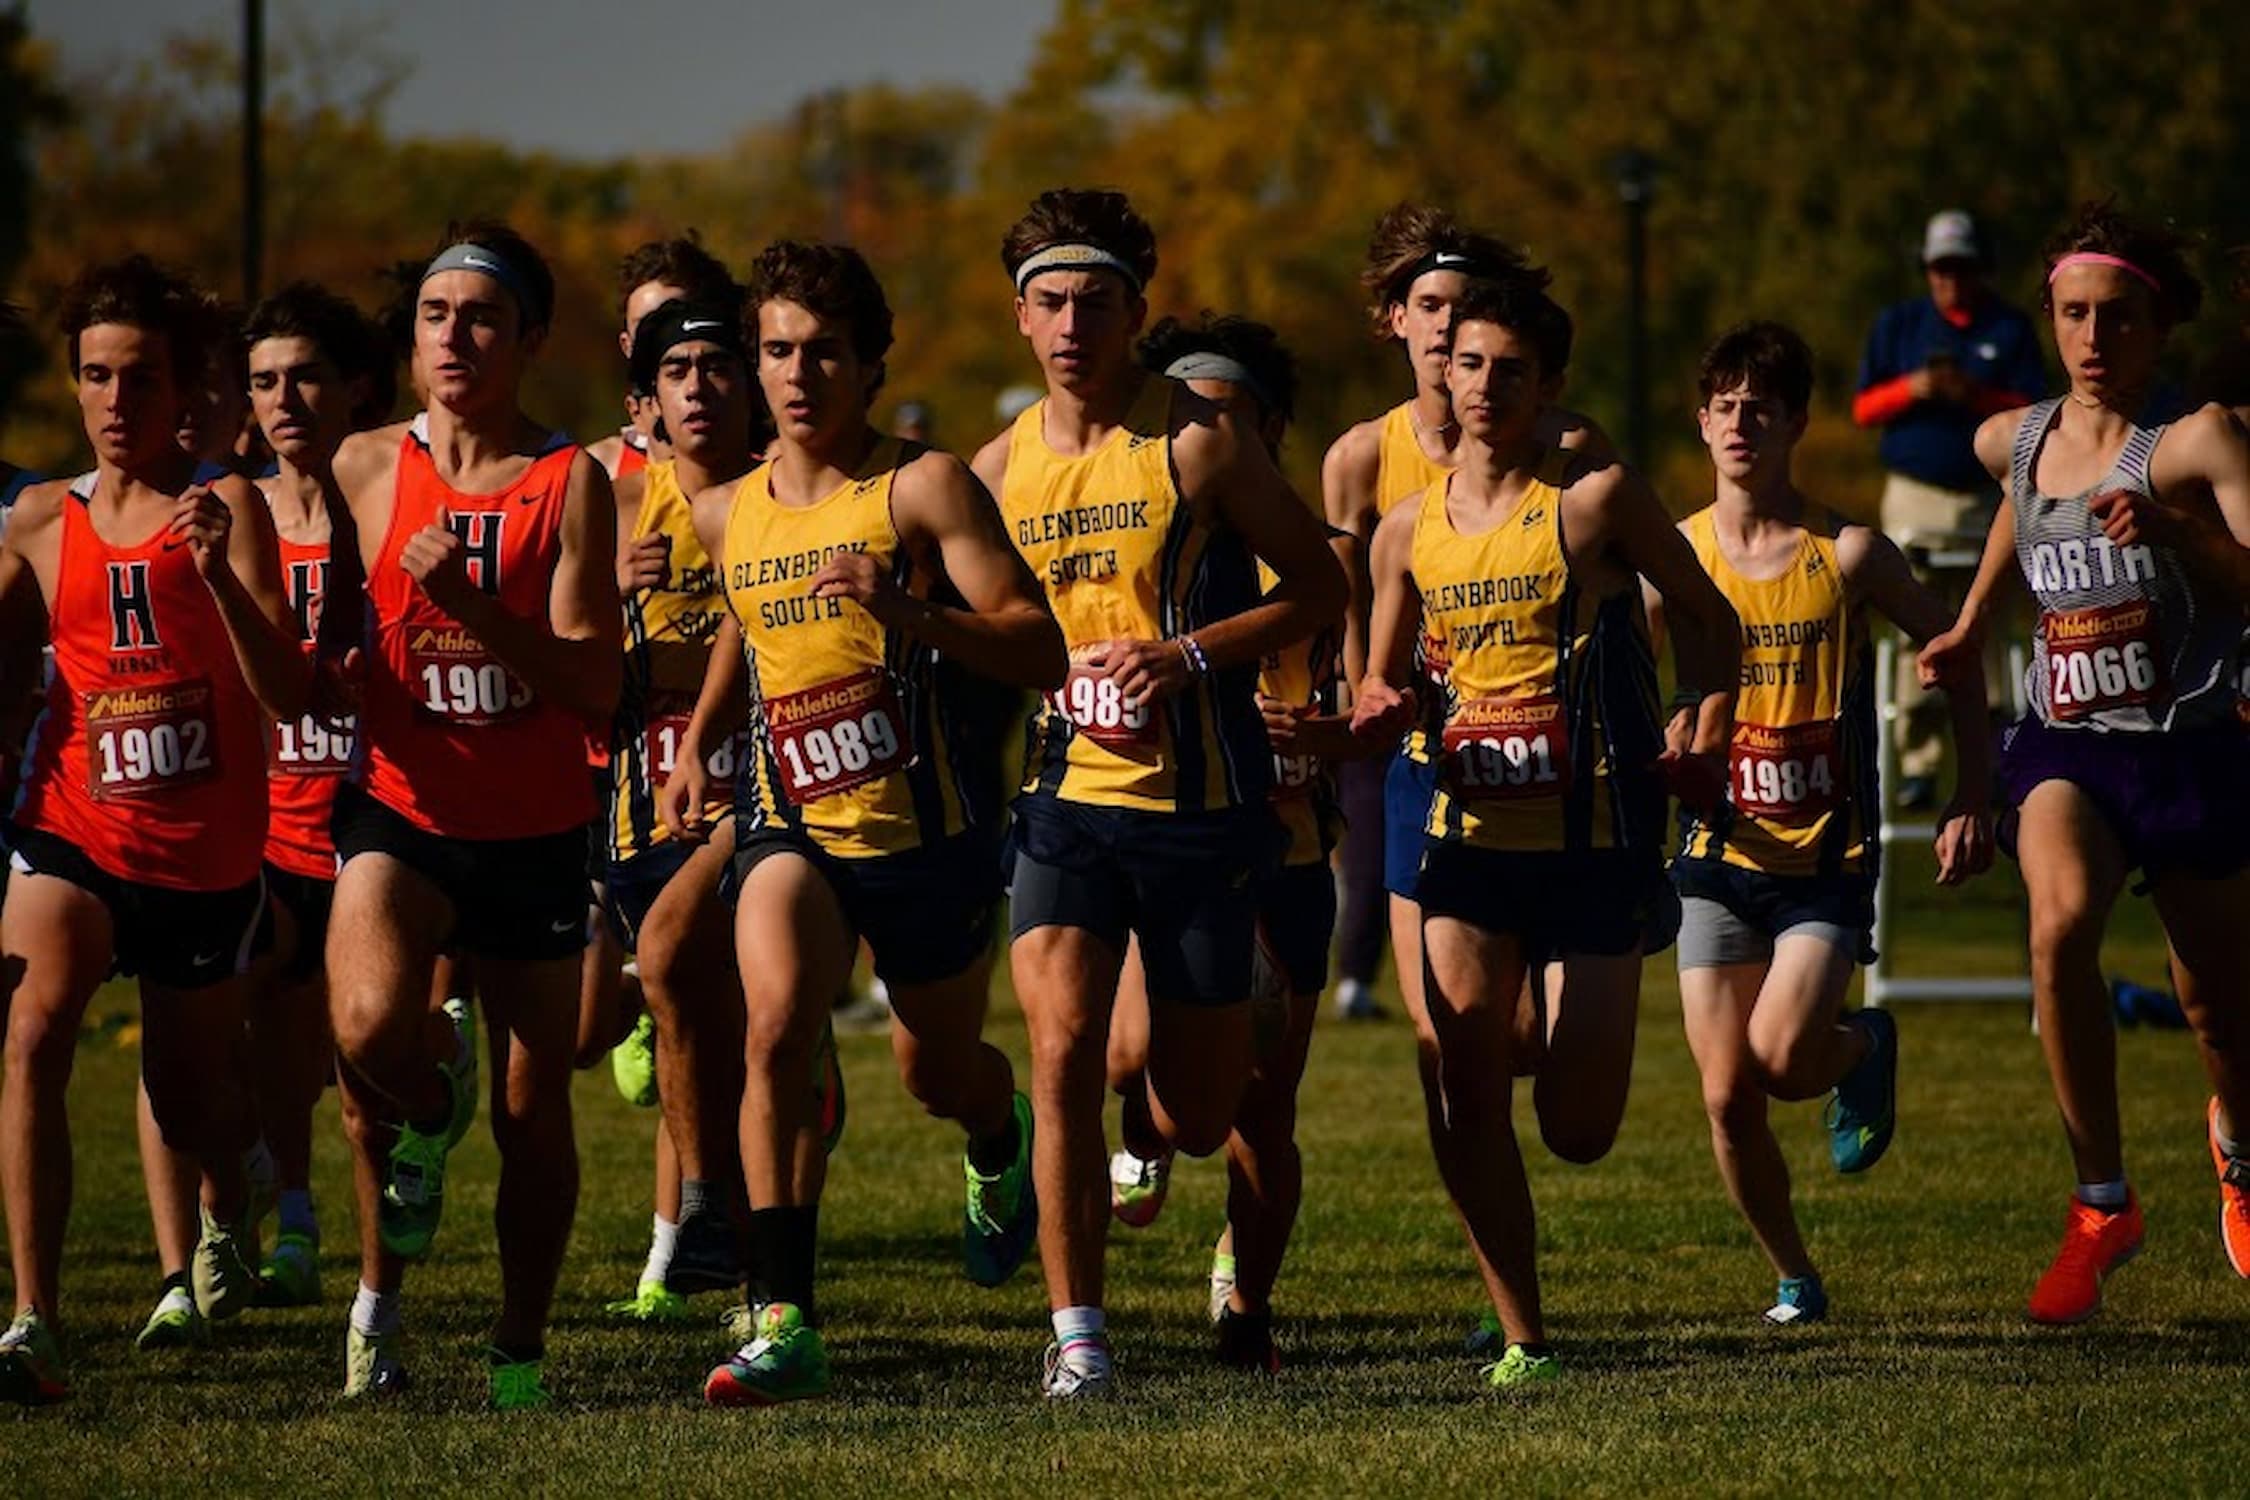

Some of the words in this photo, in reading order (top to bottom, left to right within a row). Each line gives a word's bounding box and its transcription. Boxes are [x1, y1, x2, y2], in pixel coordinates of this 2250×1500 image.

[1018, 500, 1149, 546] GLENBROOK
[448, 511, 507, 597] H
[1050, 550, 1118, 585] SOUTH
[105, 560, 163, 651] H
[761, 596, 842, 629] SOUTH
[411, 629, 485, 652] Athle
[1741, 619, 1833, 648] NBROOK
[1738, 660, 1805, 687] SOUTH
[2050, 640, 2157, 706] 2066
[88, 690, 174, 720] Athletic
[770, 689, 849, 728] Athletic
[1445, 702, 1524, 727] Athletic
[98, 718, 212, 784] 1902
[782, 708, 899, 789] 1989
[1455, 733, 1560, 787] 1991
[1738, 753, 1835, 805] 1984
